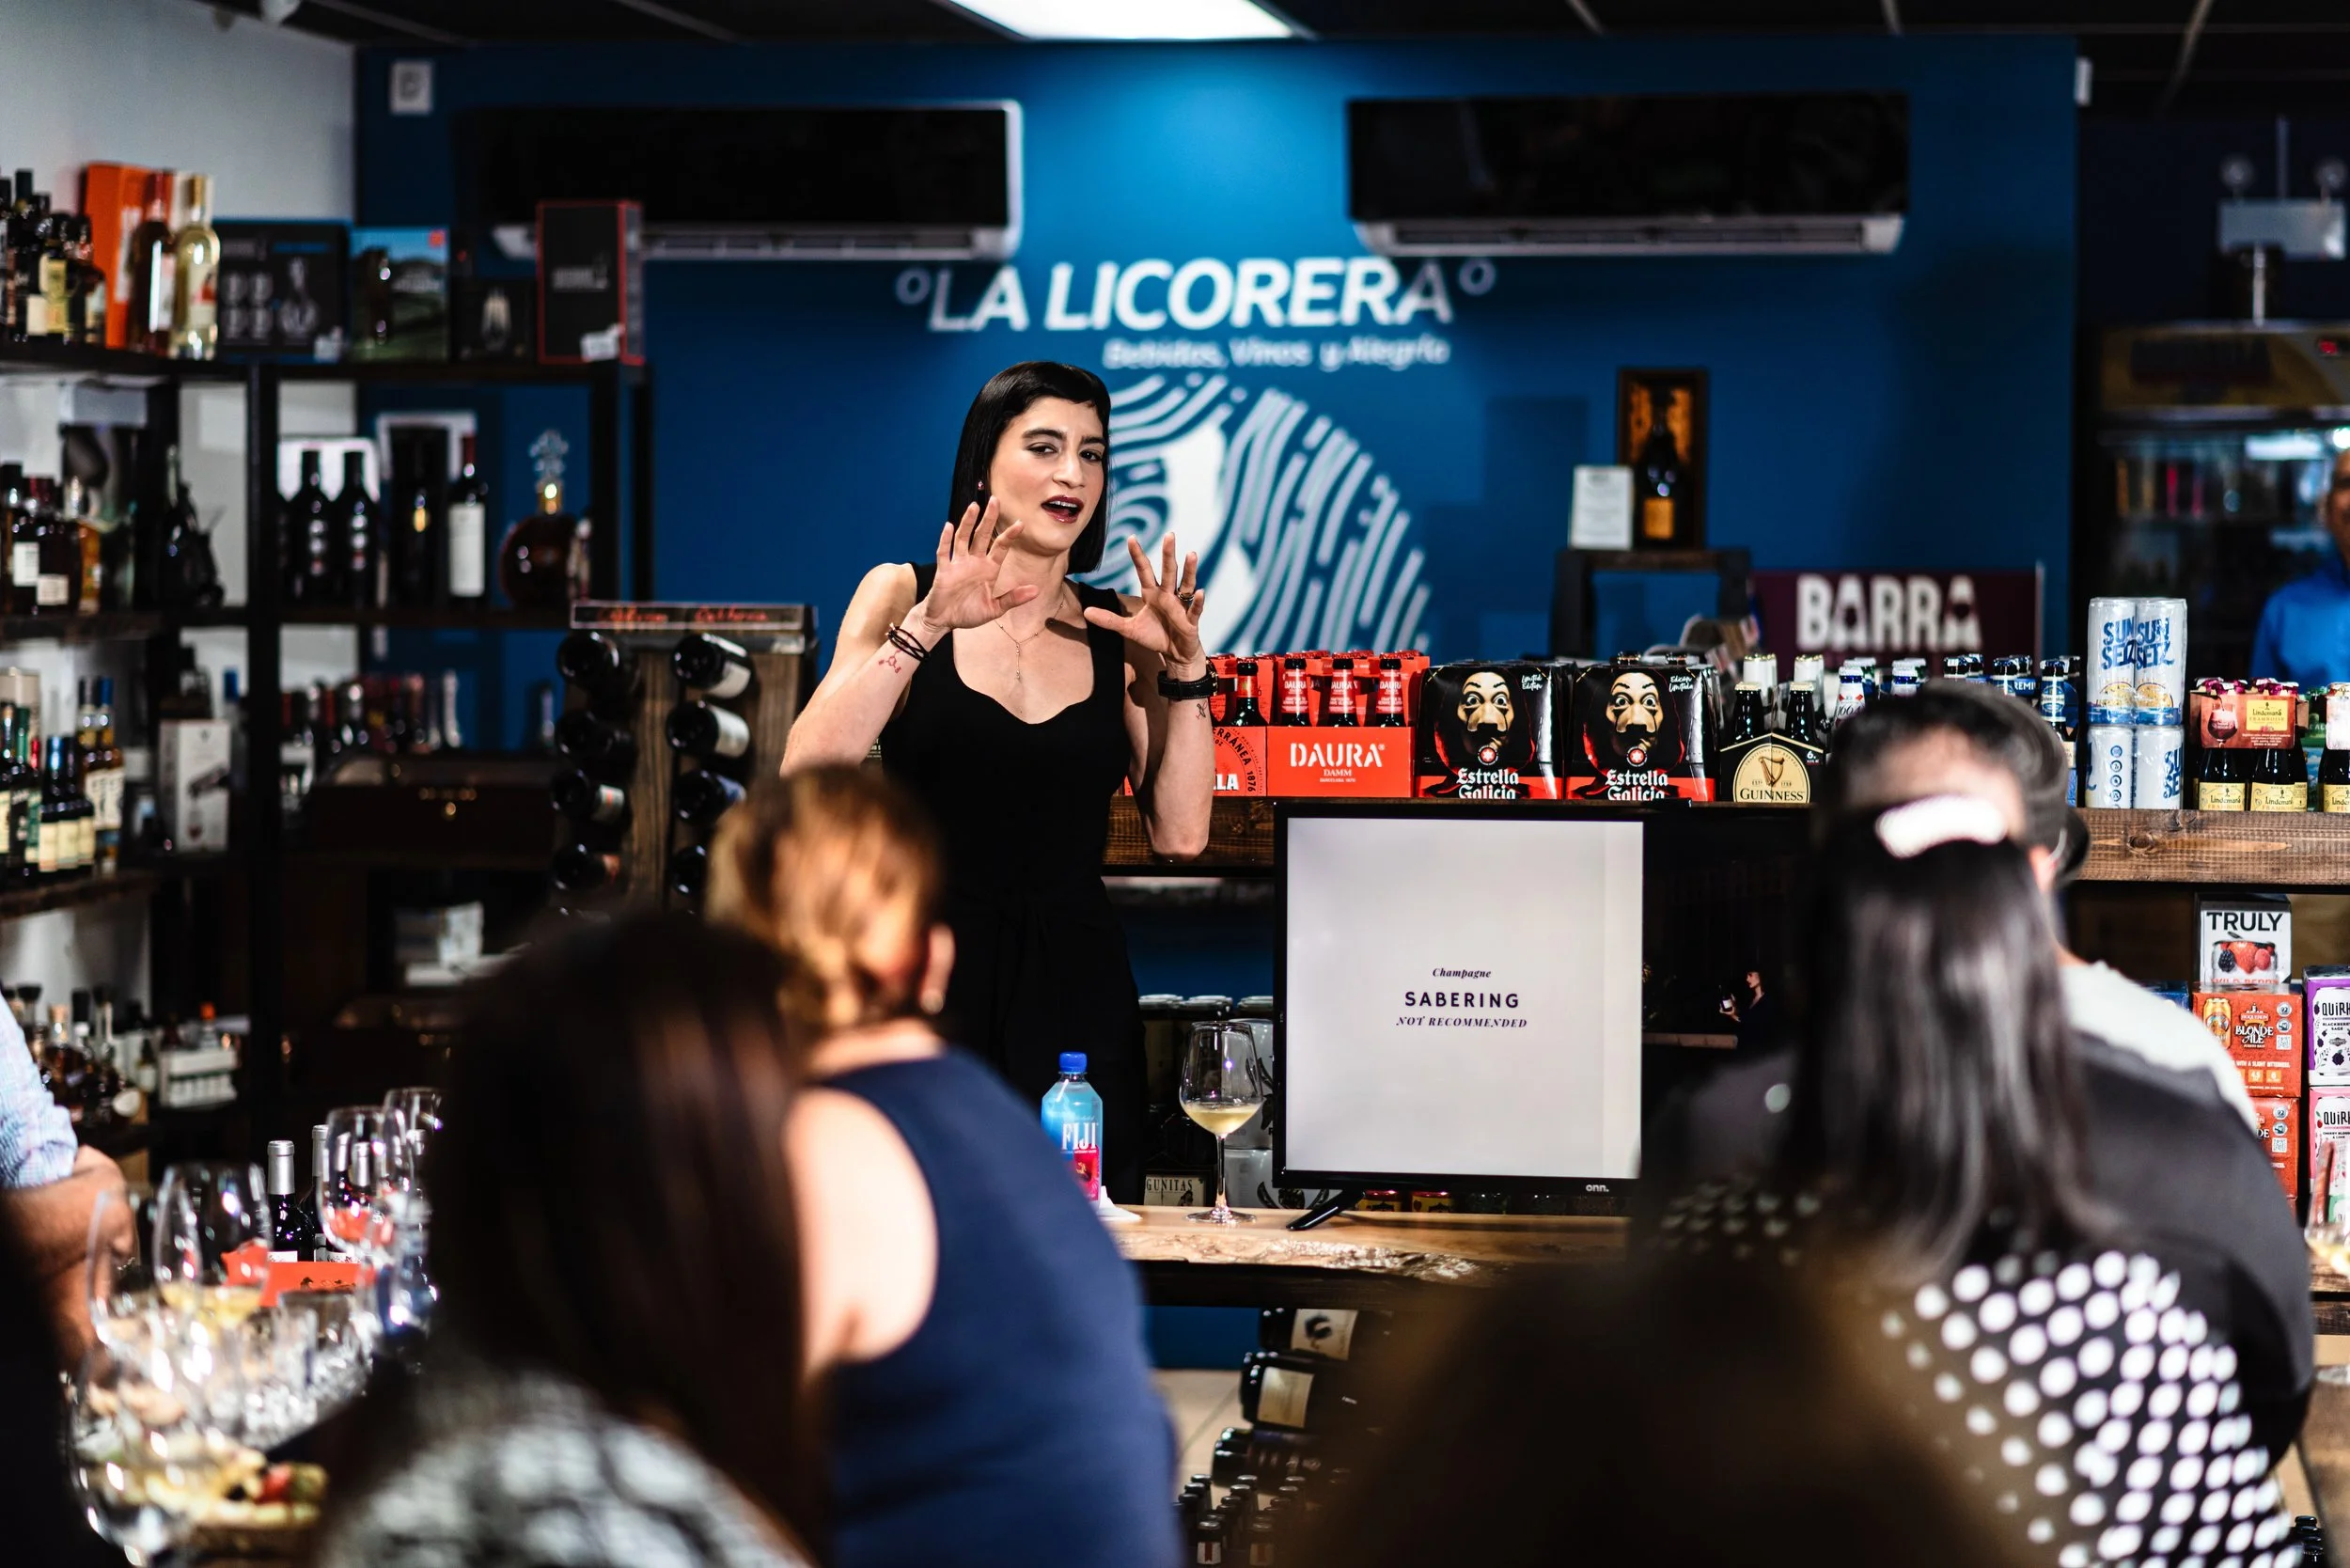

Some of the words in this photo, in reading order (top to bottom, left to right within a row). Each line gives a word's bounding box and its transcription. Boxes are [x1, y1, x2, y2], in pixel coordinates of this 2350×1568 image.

[1320, 341, 1343, 372] y
[1796, 572, 1982, 651] BARRA
[1457, 767, 1519, 785] Estrella
[1606, 768, 1668, 786] Estrella
[1459, 785, 1515, 799] Galicia
[1607, 786, 1665, 801] Galicia
[1740, 788, 1804, 801] GUINNESS
[2206, 912, 2283, 932] TRULY
[1433, 967, 1491, 979] Champagne
[1405, 991, 1518, 1009] SABERING
[1396, 1016, 1425, 1027] NOT
[1429, 1017, 1528, 1027] RECOMMENDED
[2235, 1024, 2274, 1036] BLONDE
[1062, 1122, 1096, 1150] FIJI
[1146, 1178, 1193, 1192] GUNITAS
